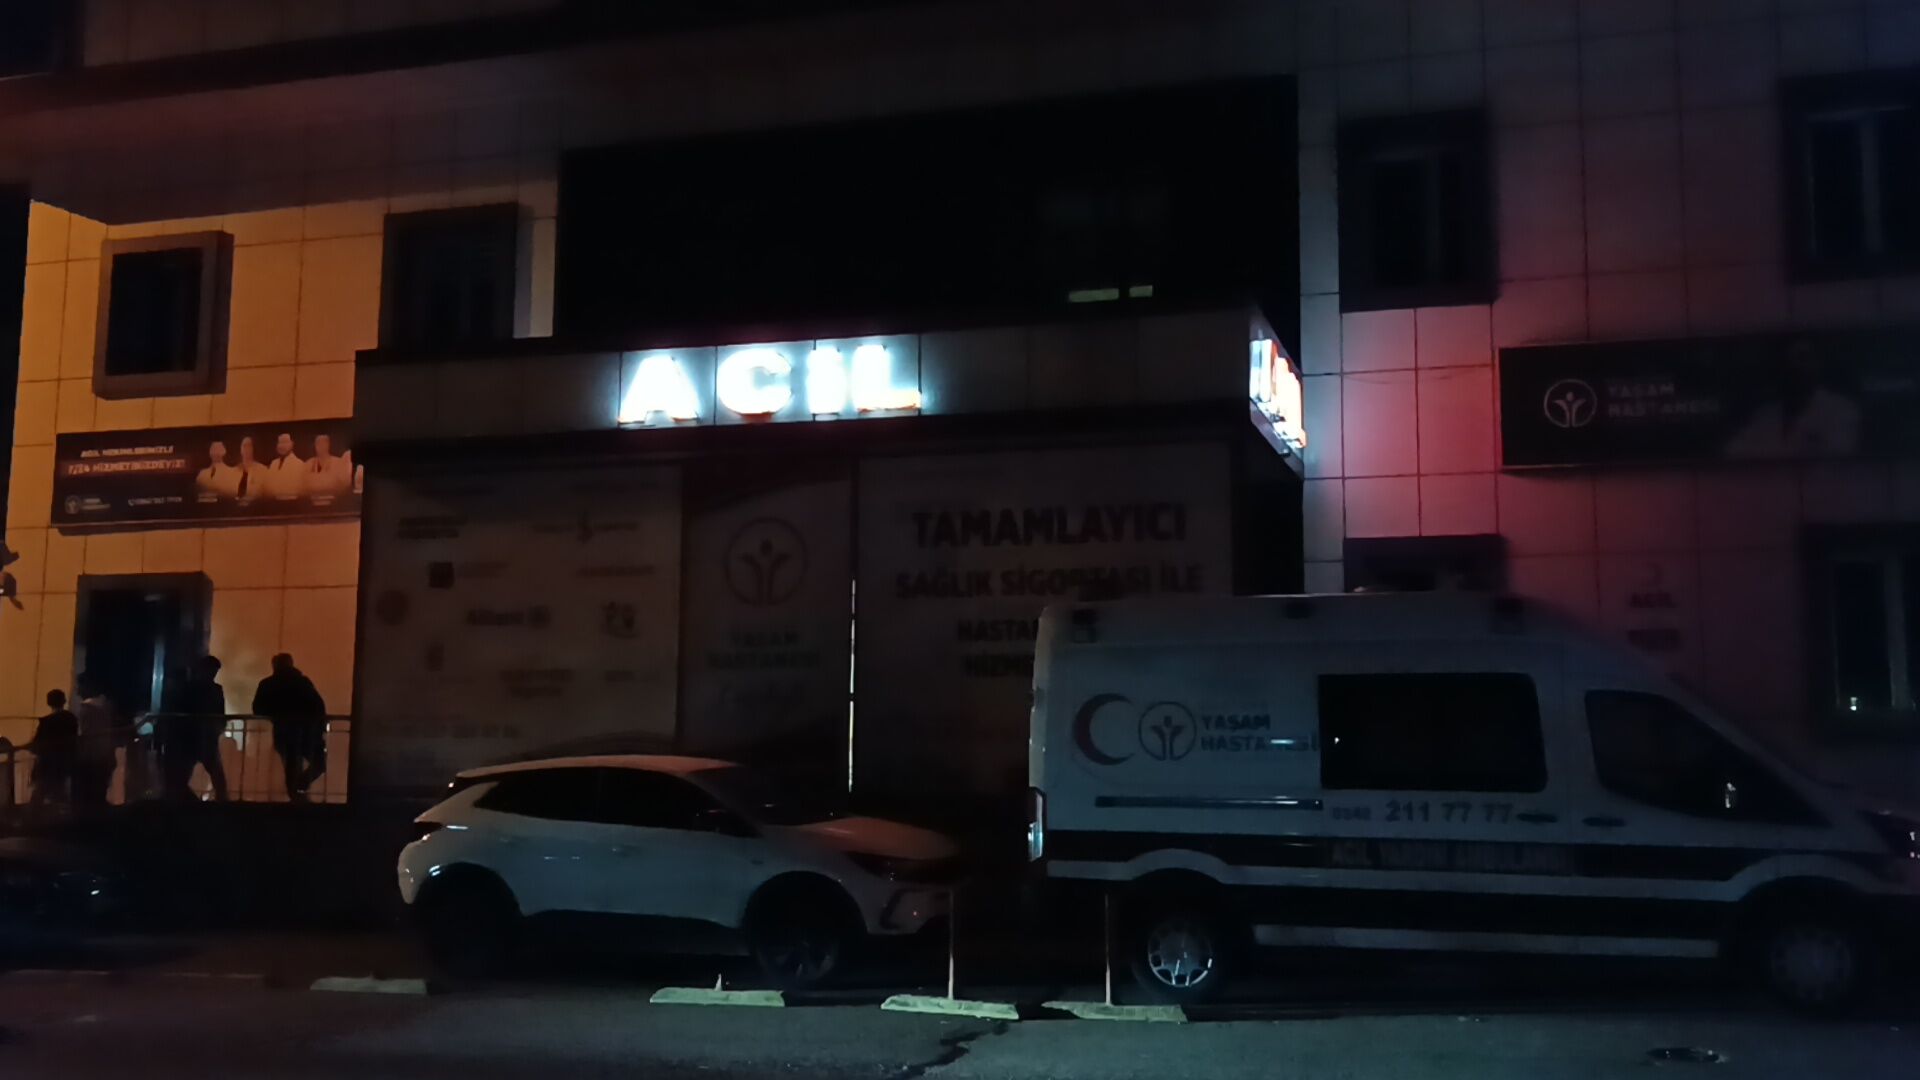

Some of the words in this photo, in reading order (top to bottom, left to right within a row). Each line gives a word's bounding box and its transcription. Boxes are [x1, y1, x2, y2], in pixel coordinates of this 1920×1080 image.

[616, 344, 922, 425] ACİL
[913, 503, 1187, 546] TAMAMLAYICI
[896, 568, 993, 599] SAĞLIK
[1159, 560, 1207, 593] İLE
[1385, 800, 1430, 822] 211
[1441, 802, 1473, 823] 77
[1482, 803, 1513, 823] 77
